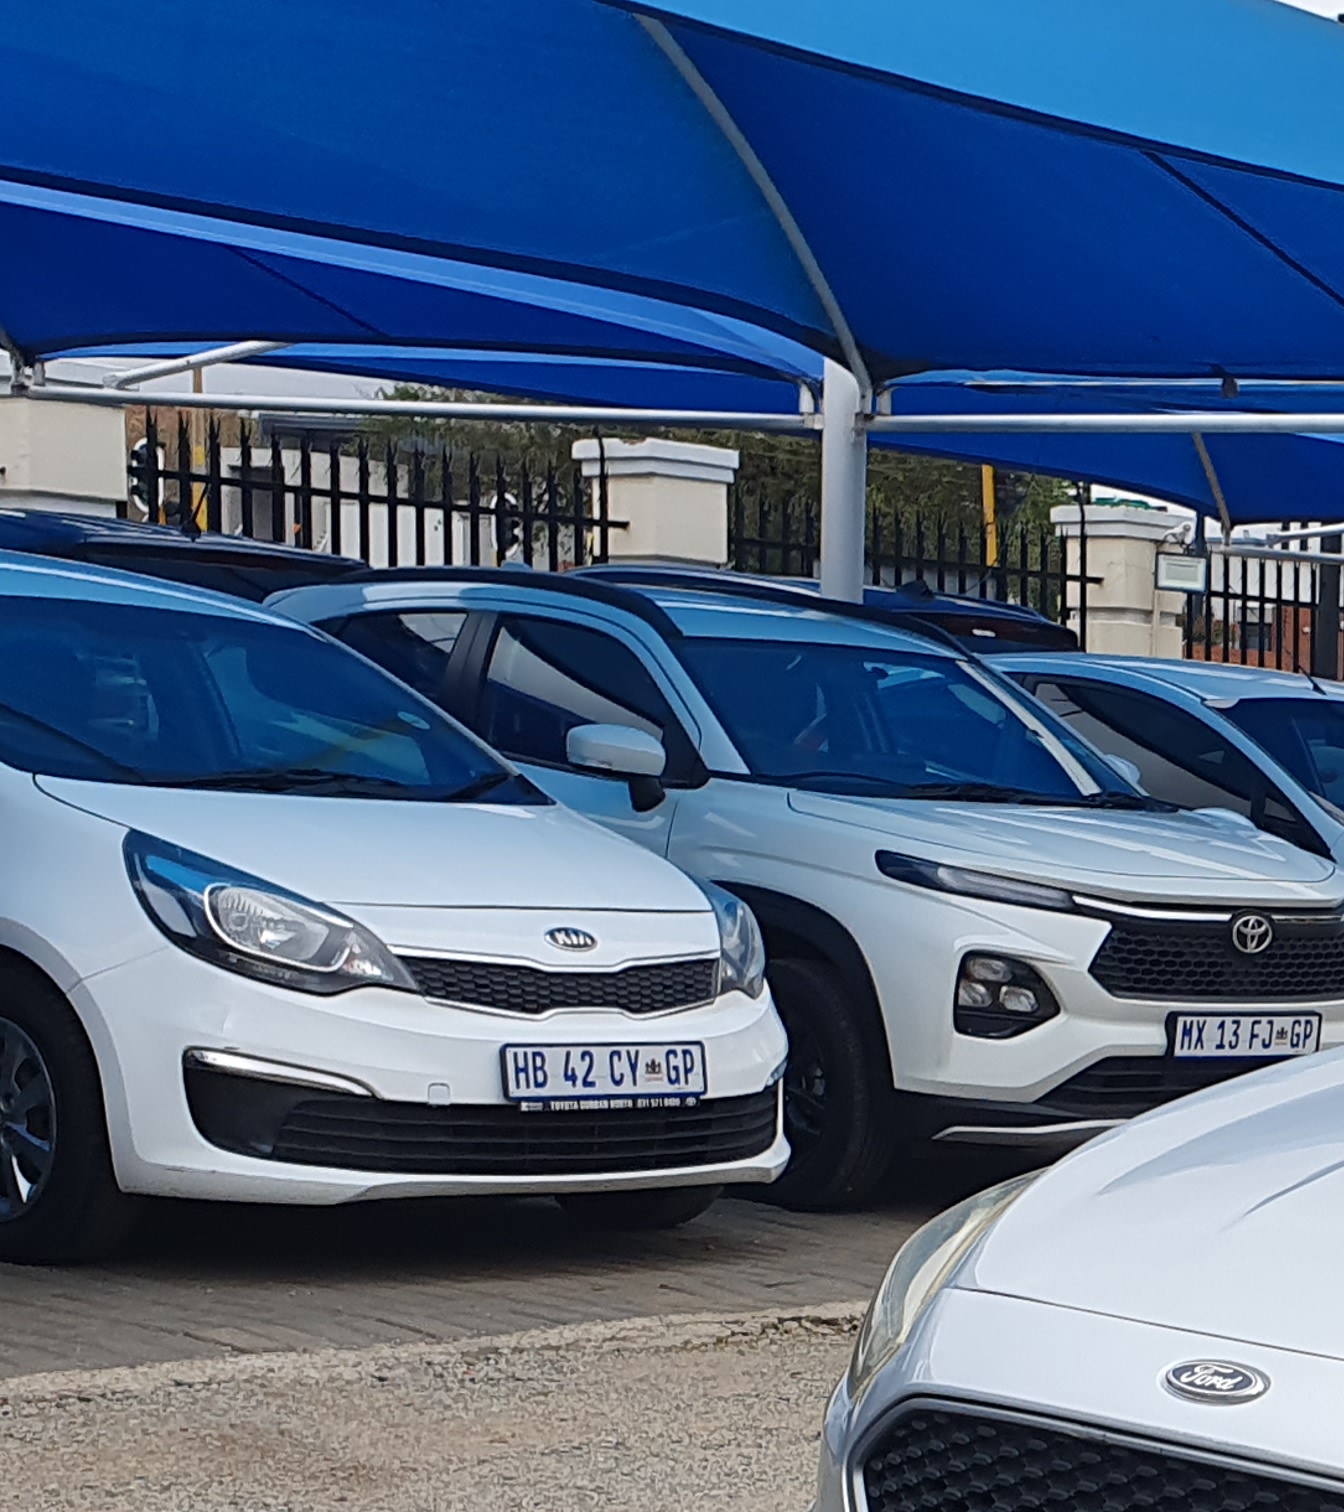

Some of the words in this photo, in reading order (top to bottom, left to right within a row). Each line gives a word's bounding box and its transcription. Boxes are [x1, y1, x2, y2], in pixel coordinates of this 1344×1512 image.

[553, 929, 593, 946] KIA
[1180, 1019, 1207, 1051] MX
[1215, 1019, 1242, 1050] 13
[1249, 1019, 1274, 1050] FJ
[1289, 1019, 1314, 1049] GP
[513, 1050, 548, 1090] HB
[563, 1050, 597, 1089] 42
[609, 1049, 640, 1087] CY
[665, 1048, 695, 1086] GP
[1180, 1363, 1243, 1390] Ford
